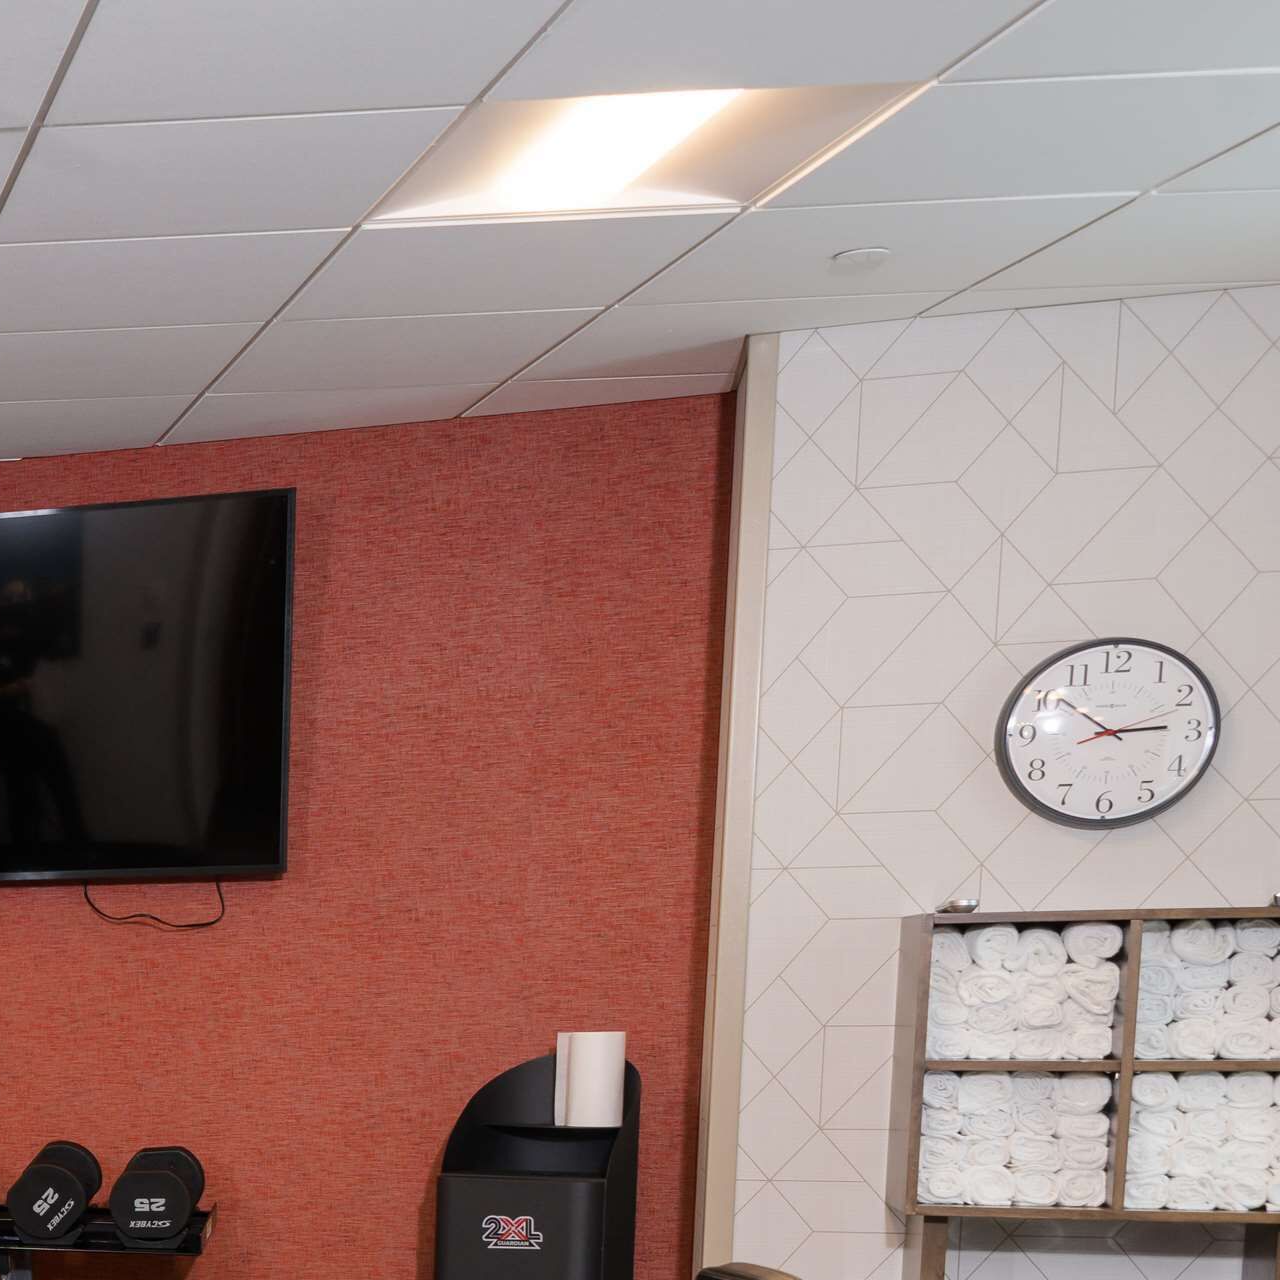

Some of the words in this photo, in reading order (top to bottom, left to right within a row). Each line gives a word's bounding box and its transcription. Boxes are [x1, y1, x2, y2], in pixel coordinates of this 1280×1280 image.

[1100, 650, 1132, 674] 12
[1153, 660, 1167, 684] 1
[1064, 664, 1091, 687] 11
[1032, 688, 1060, 713] 10
[1175, 684, 1194, 707] 2
[1018, 724, 1037, 747] 9
[1184, 719, 1202, 742] 3
[1027, 758, 1046, 781] 8
[1167, 754, 1186, 777] 4
[1056, 783, 1073, 806] 7
[1095, 790, 1113, 814] 6
[1137, 780, 1155, 803] 5
[32, 1187, 60, 1217] 25
[134, 1198, 166, 1212] 25
[129, 1220, 158, 1228] CYBEX
[481, 1215, 543, 1242] 2XL
